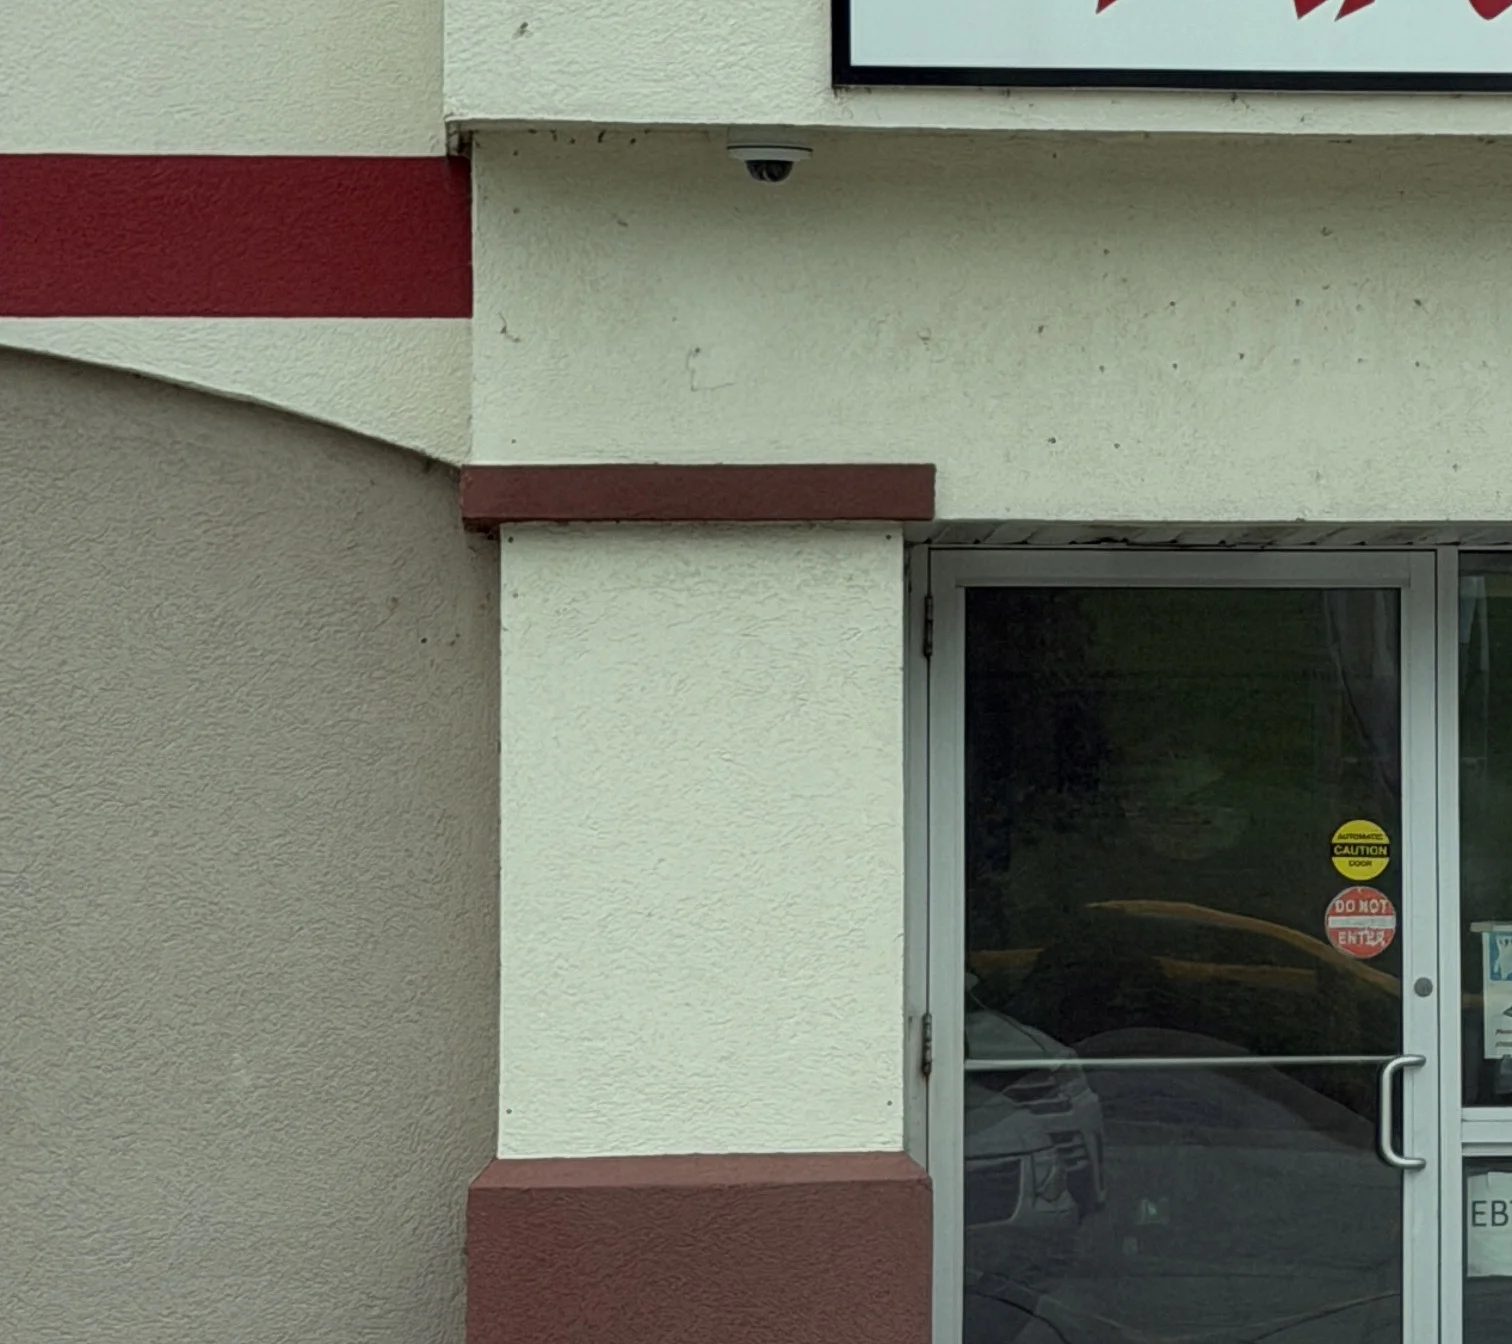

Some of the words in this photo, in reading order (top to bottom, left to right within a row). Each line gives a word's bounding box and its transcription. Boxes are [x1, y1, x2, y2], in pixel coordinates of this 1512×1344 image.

[1333, 845, 1388, 856] CAUTION
[1334, 899, 1356, 913] DO
[1359, 898, 1388, 913] NOT
